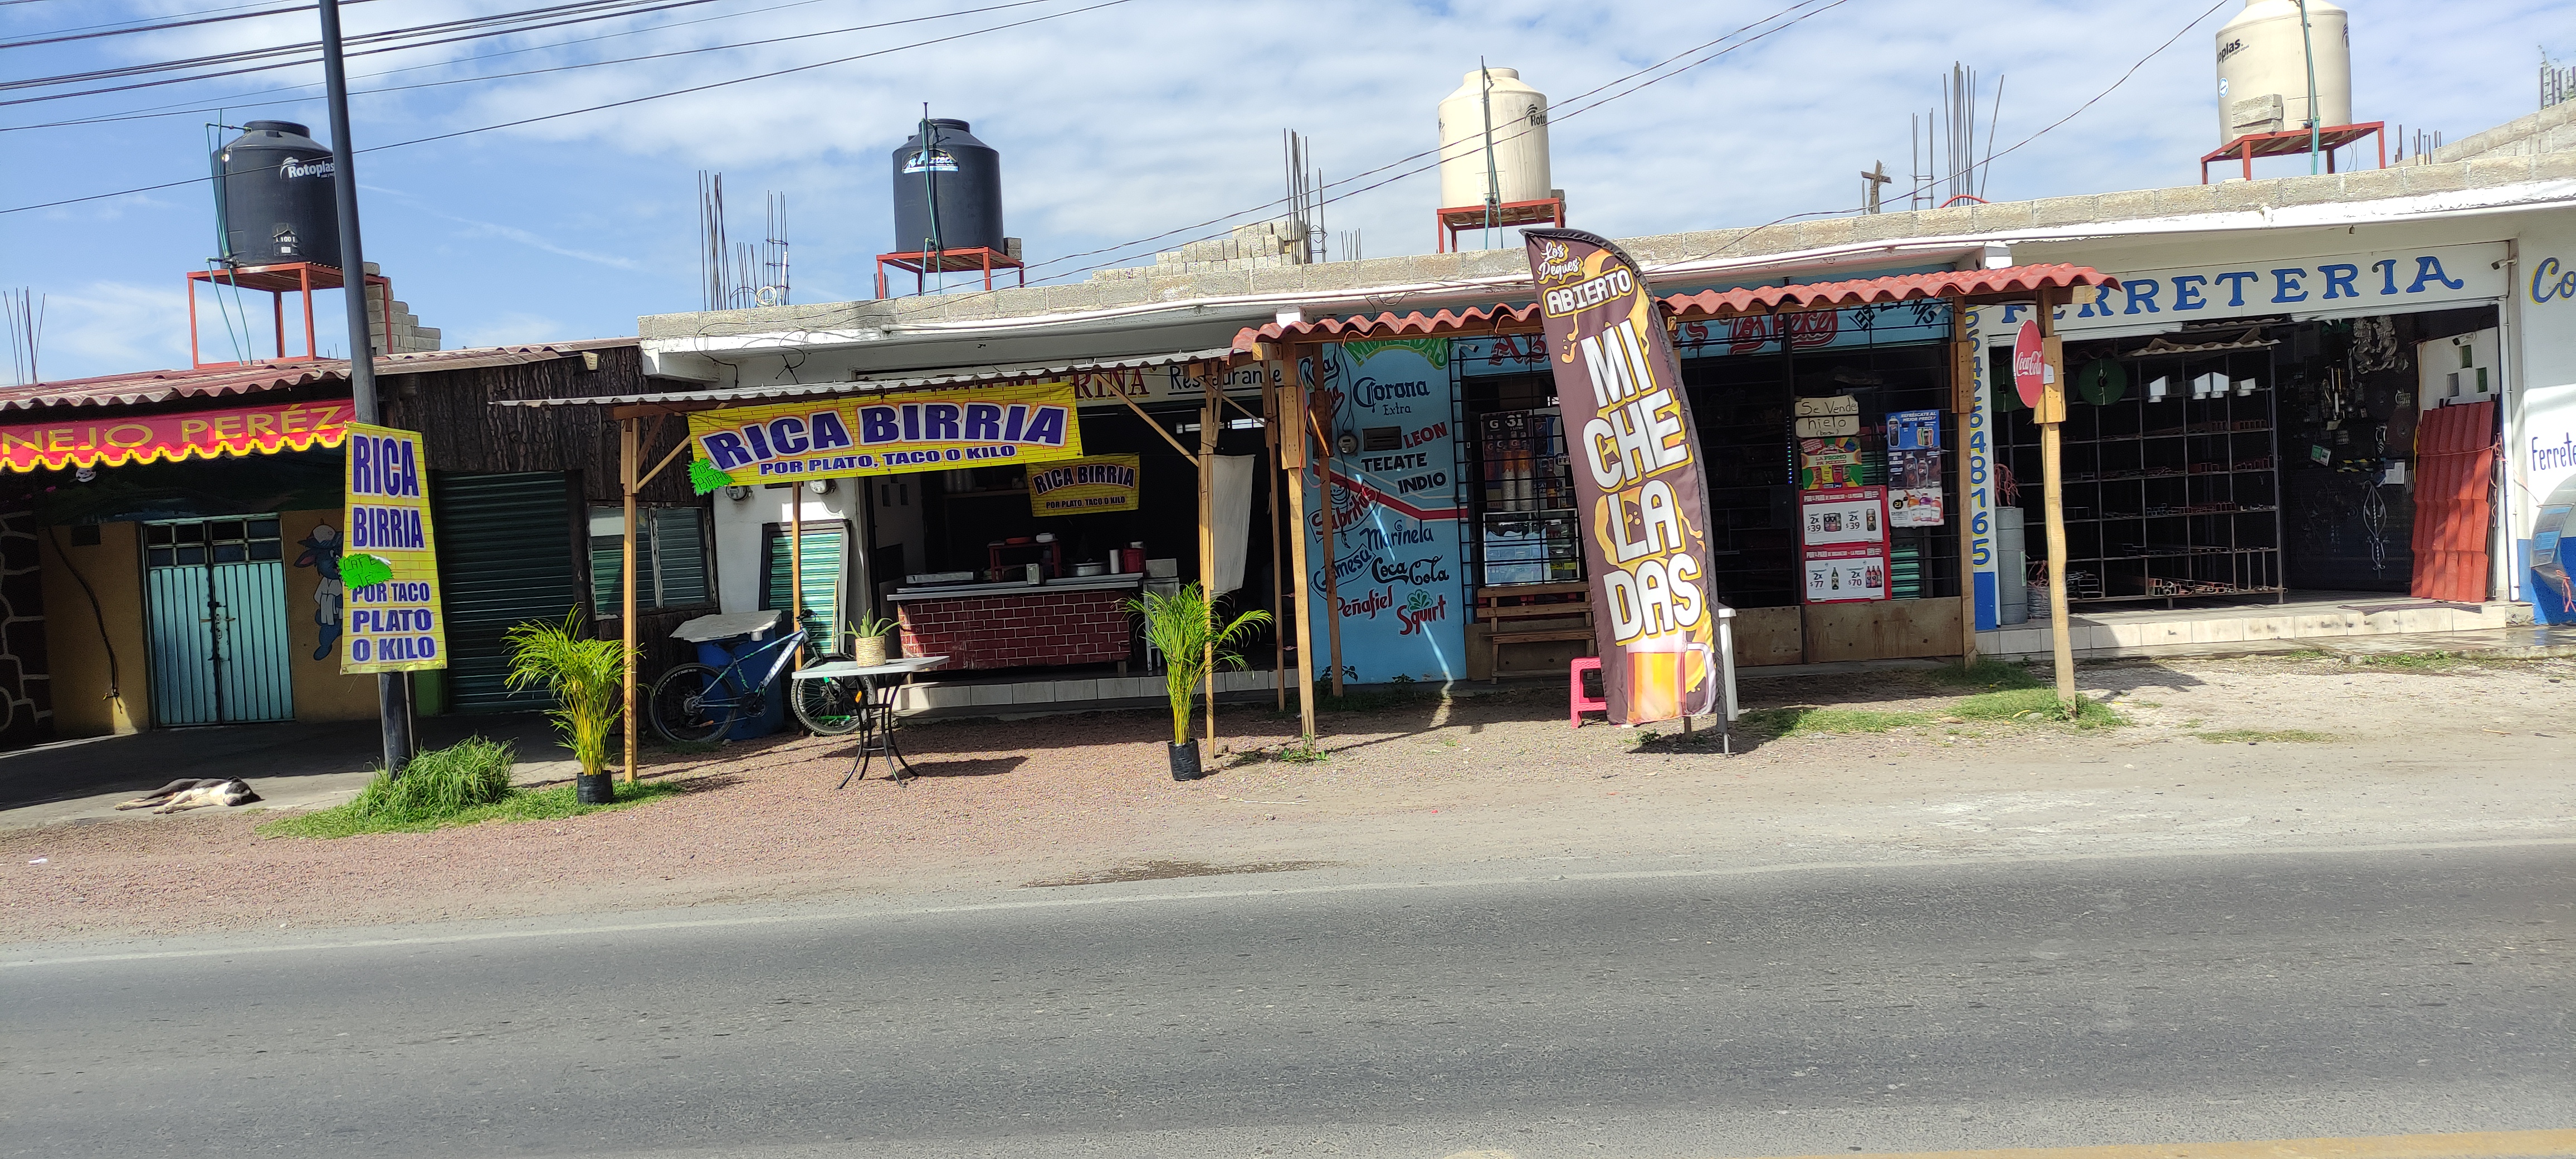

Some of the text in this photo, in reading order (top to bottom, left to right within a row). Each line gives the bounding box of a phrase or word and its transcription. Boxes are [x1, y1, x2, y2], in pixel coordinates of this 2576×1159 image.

[287, 160, 334, 178] Rotoplas
[1541, 242, 1565, 261] Los
[1538, 257, 1581, 280] Peques
[1546, 270, 1632, 314] ABIERTO
[2002, 256, 2464, 323] FRRETERIA
[1170, 366, 1282, 390] Resaurane
[1580, 319, 1653, 408] MI
[1353, 377, 1431, 413] Corona
[1383, 402, 1412, 416] Extra
[1801, 397, 1857, 415] Se Vende
[181, 403, 344, 443] PERÉZ
[701, 403, 1067, 471] RICA BIRRIA
[1402, 421, 1448, 450] LEON
[1808, 415, 1846, 430] hielo
[1583, 388, 1689, 489] CHE
[353, 435, 421, 498] RICA
[760, 444, 1017, 475] POR PLATO, TACO O KILO
[1360, 452, 1428, 473] TECATE
[1032, 465, 1135, 495] RICA BIRRIA
[1397, 472, 1446, 494] INDIO
[1110, 496, 1125, 504] KILO
[352, 507, 425, 548] BIRRIA
[1359, 519, 1434, 551] Marinela
[1607, 480, 1681, 563] LA
[1313, 549, 1372, 592] Gmesa
[352, 582, 431, 603] POR TACO
[1603, 553, 1702, 641] DAS
[352, 608, 433, 633] PLATO
[1397, 594, 1447, 635] Squirt
[352, 636, 436, 662] O KILO
